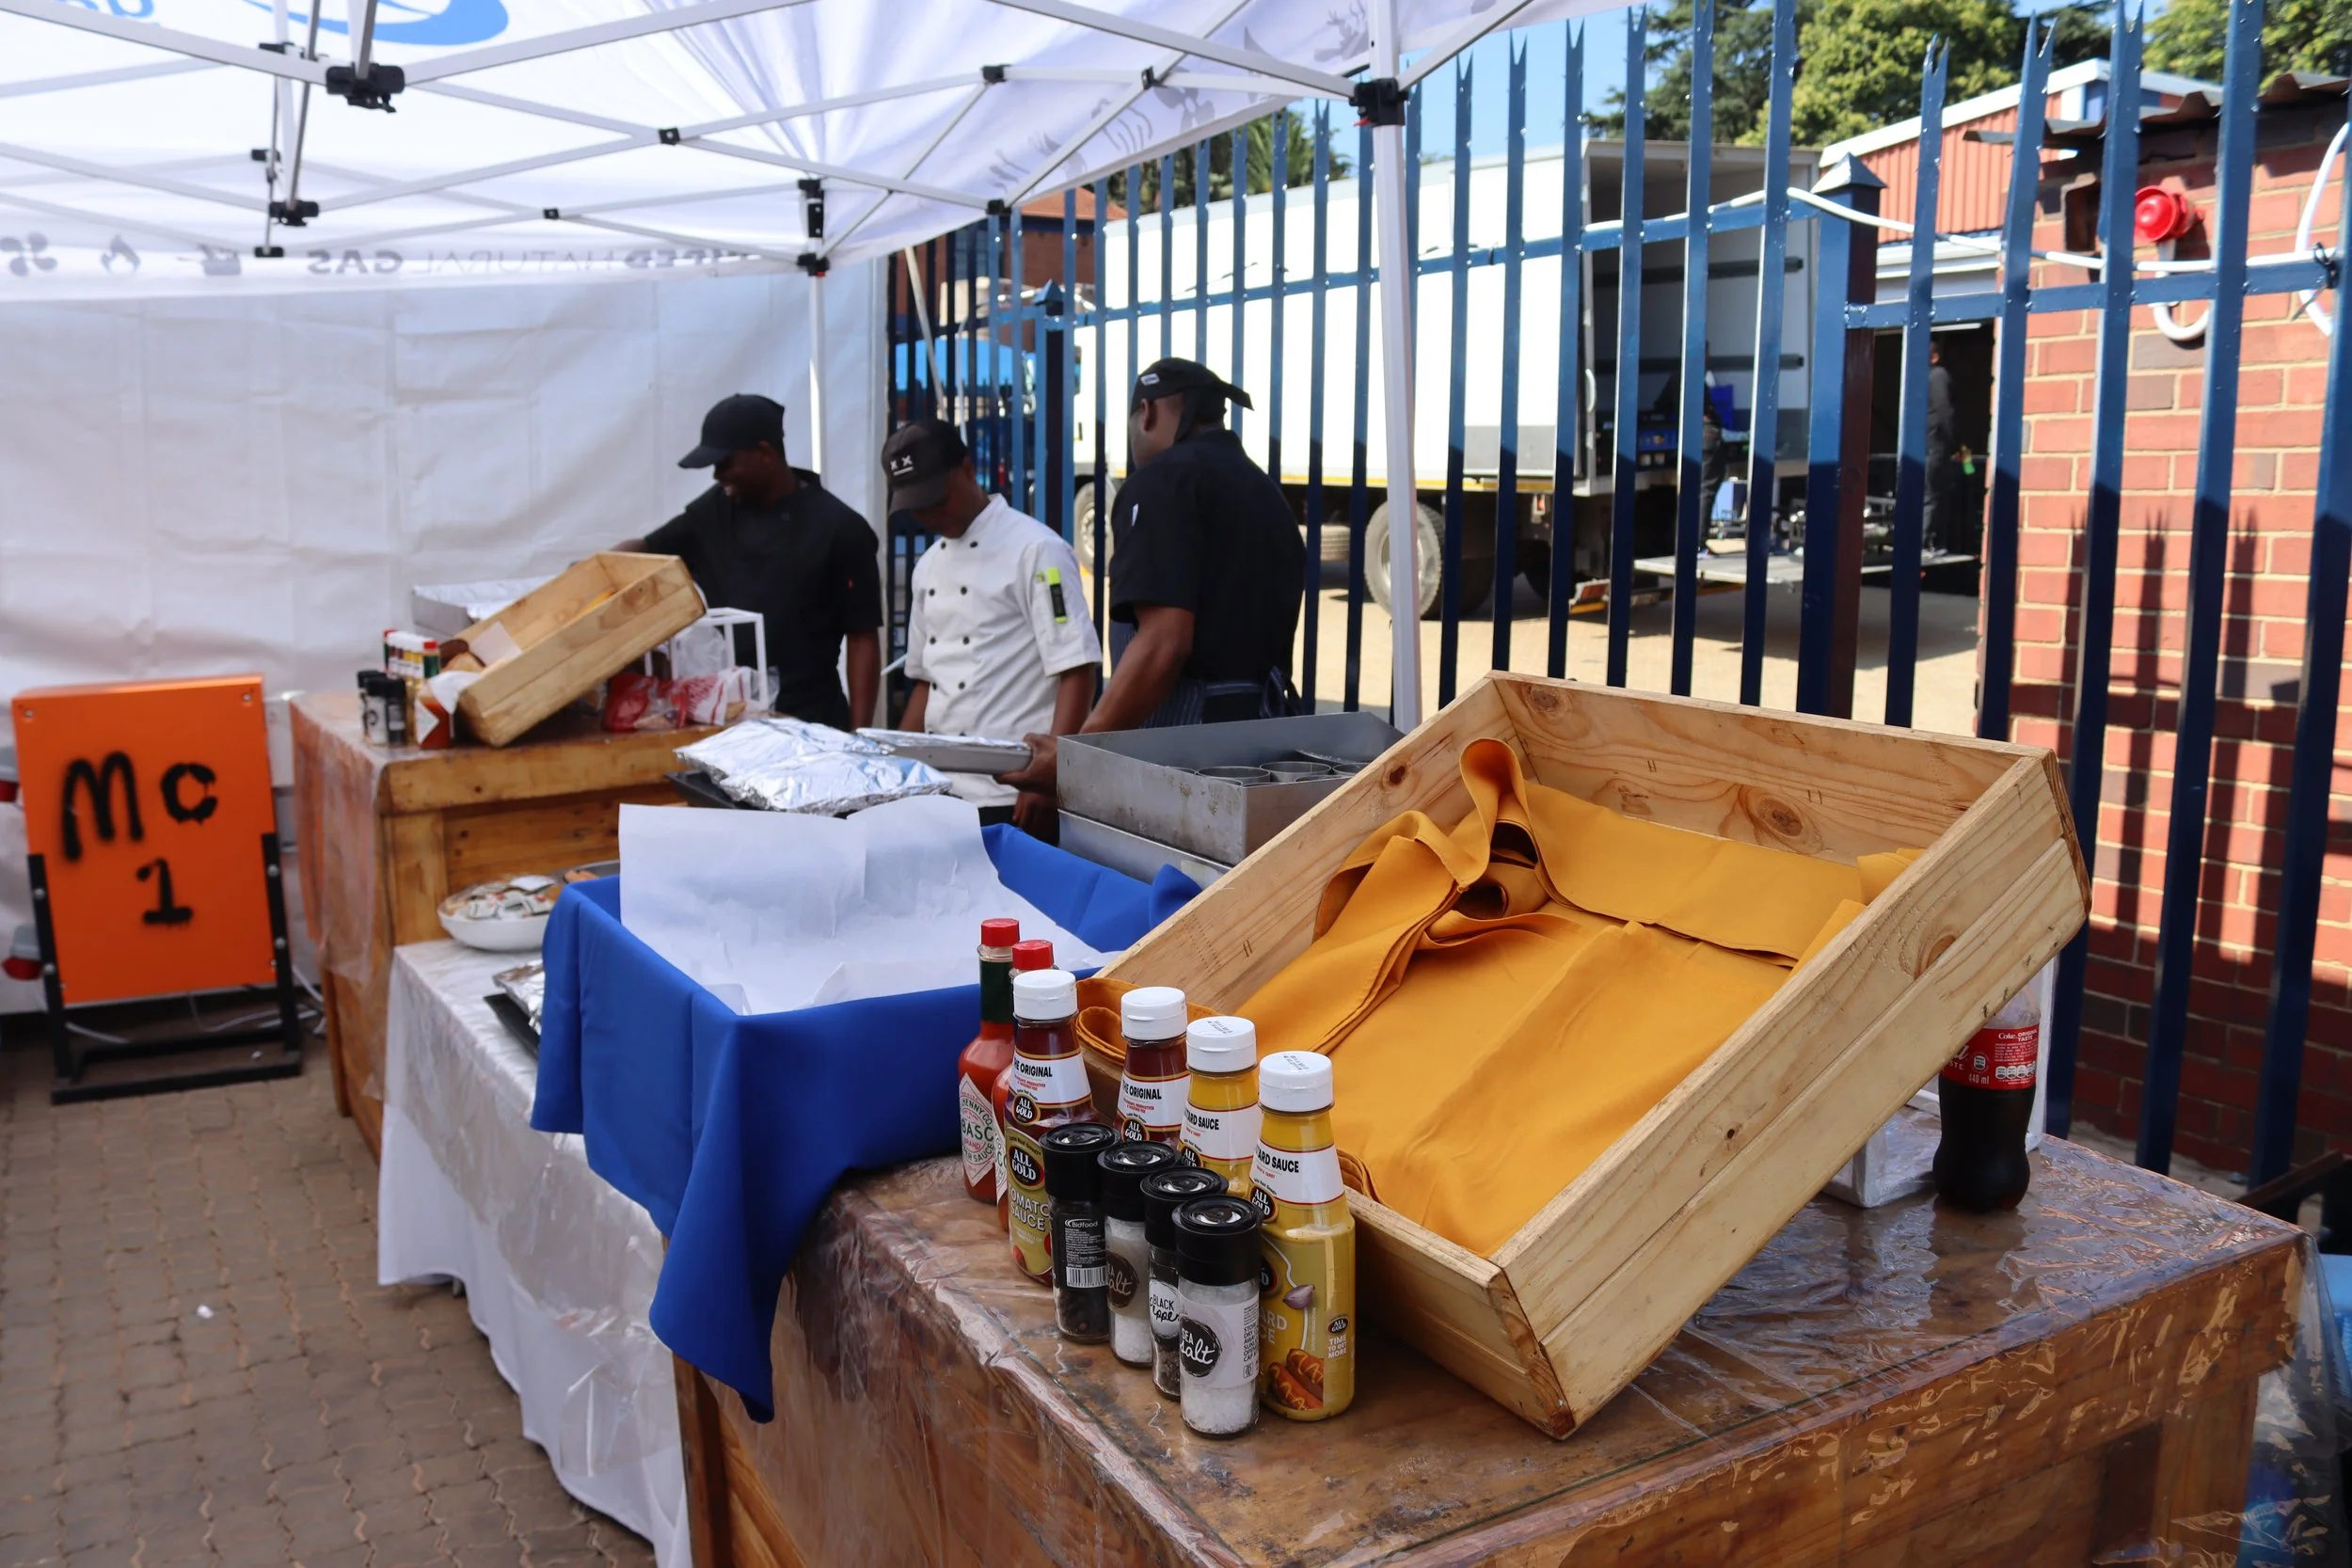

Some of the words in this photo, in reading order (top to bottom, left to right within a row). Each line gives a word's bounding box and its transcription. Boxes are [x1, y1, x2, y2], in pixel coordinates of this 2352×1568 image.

[135, 857, 194, 929] 1
[1998, 1032, 2015, 1040] Coke
[1020, 1063, 1053, 1078] ORIGINAL
[1129, 1085, 1162, 1101] ORIGINAL
[1019, 1097, 1032, 1110] ALL
[1015, 1105, 1033, 1119] GOLD
[1128, 1121, 1141, 1133] ALL
[1198, 1116, 1220, 1131] SAUCE
[1124, 1128, 1143, 1141] GOLD
[973, 1143, 995, 1163] SAUCE
[1013, 1148, 1033, 1167] ALL
[1184, 1148, 1197, 1163] ALL
[1011, 1160, 1037, 1180] GOLD
[1271, 1156, 1300, 1174] SAUCE
[1254, 1188, 1269, 1205] ALL
[1010, 1201, 1046, 1231] SAUCE
[1152, 1294, 1175, 1312] BLACK
[1333, 1319, 1344, 1327] ALL
[1181, 1328, 1194, 1346] SEA
[1328, 1334, 1347, 1345] TIME
[1327, 1348, 1347, 1359] MORE
